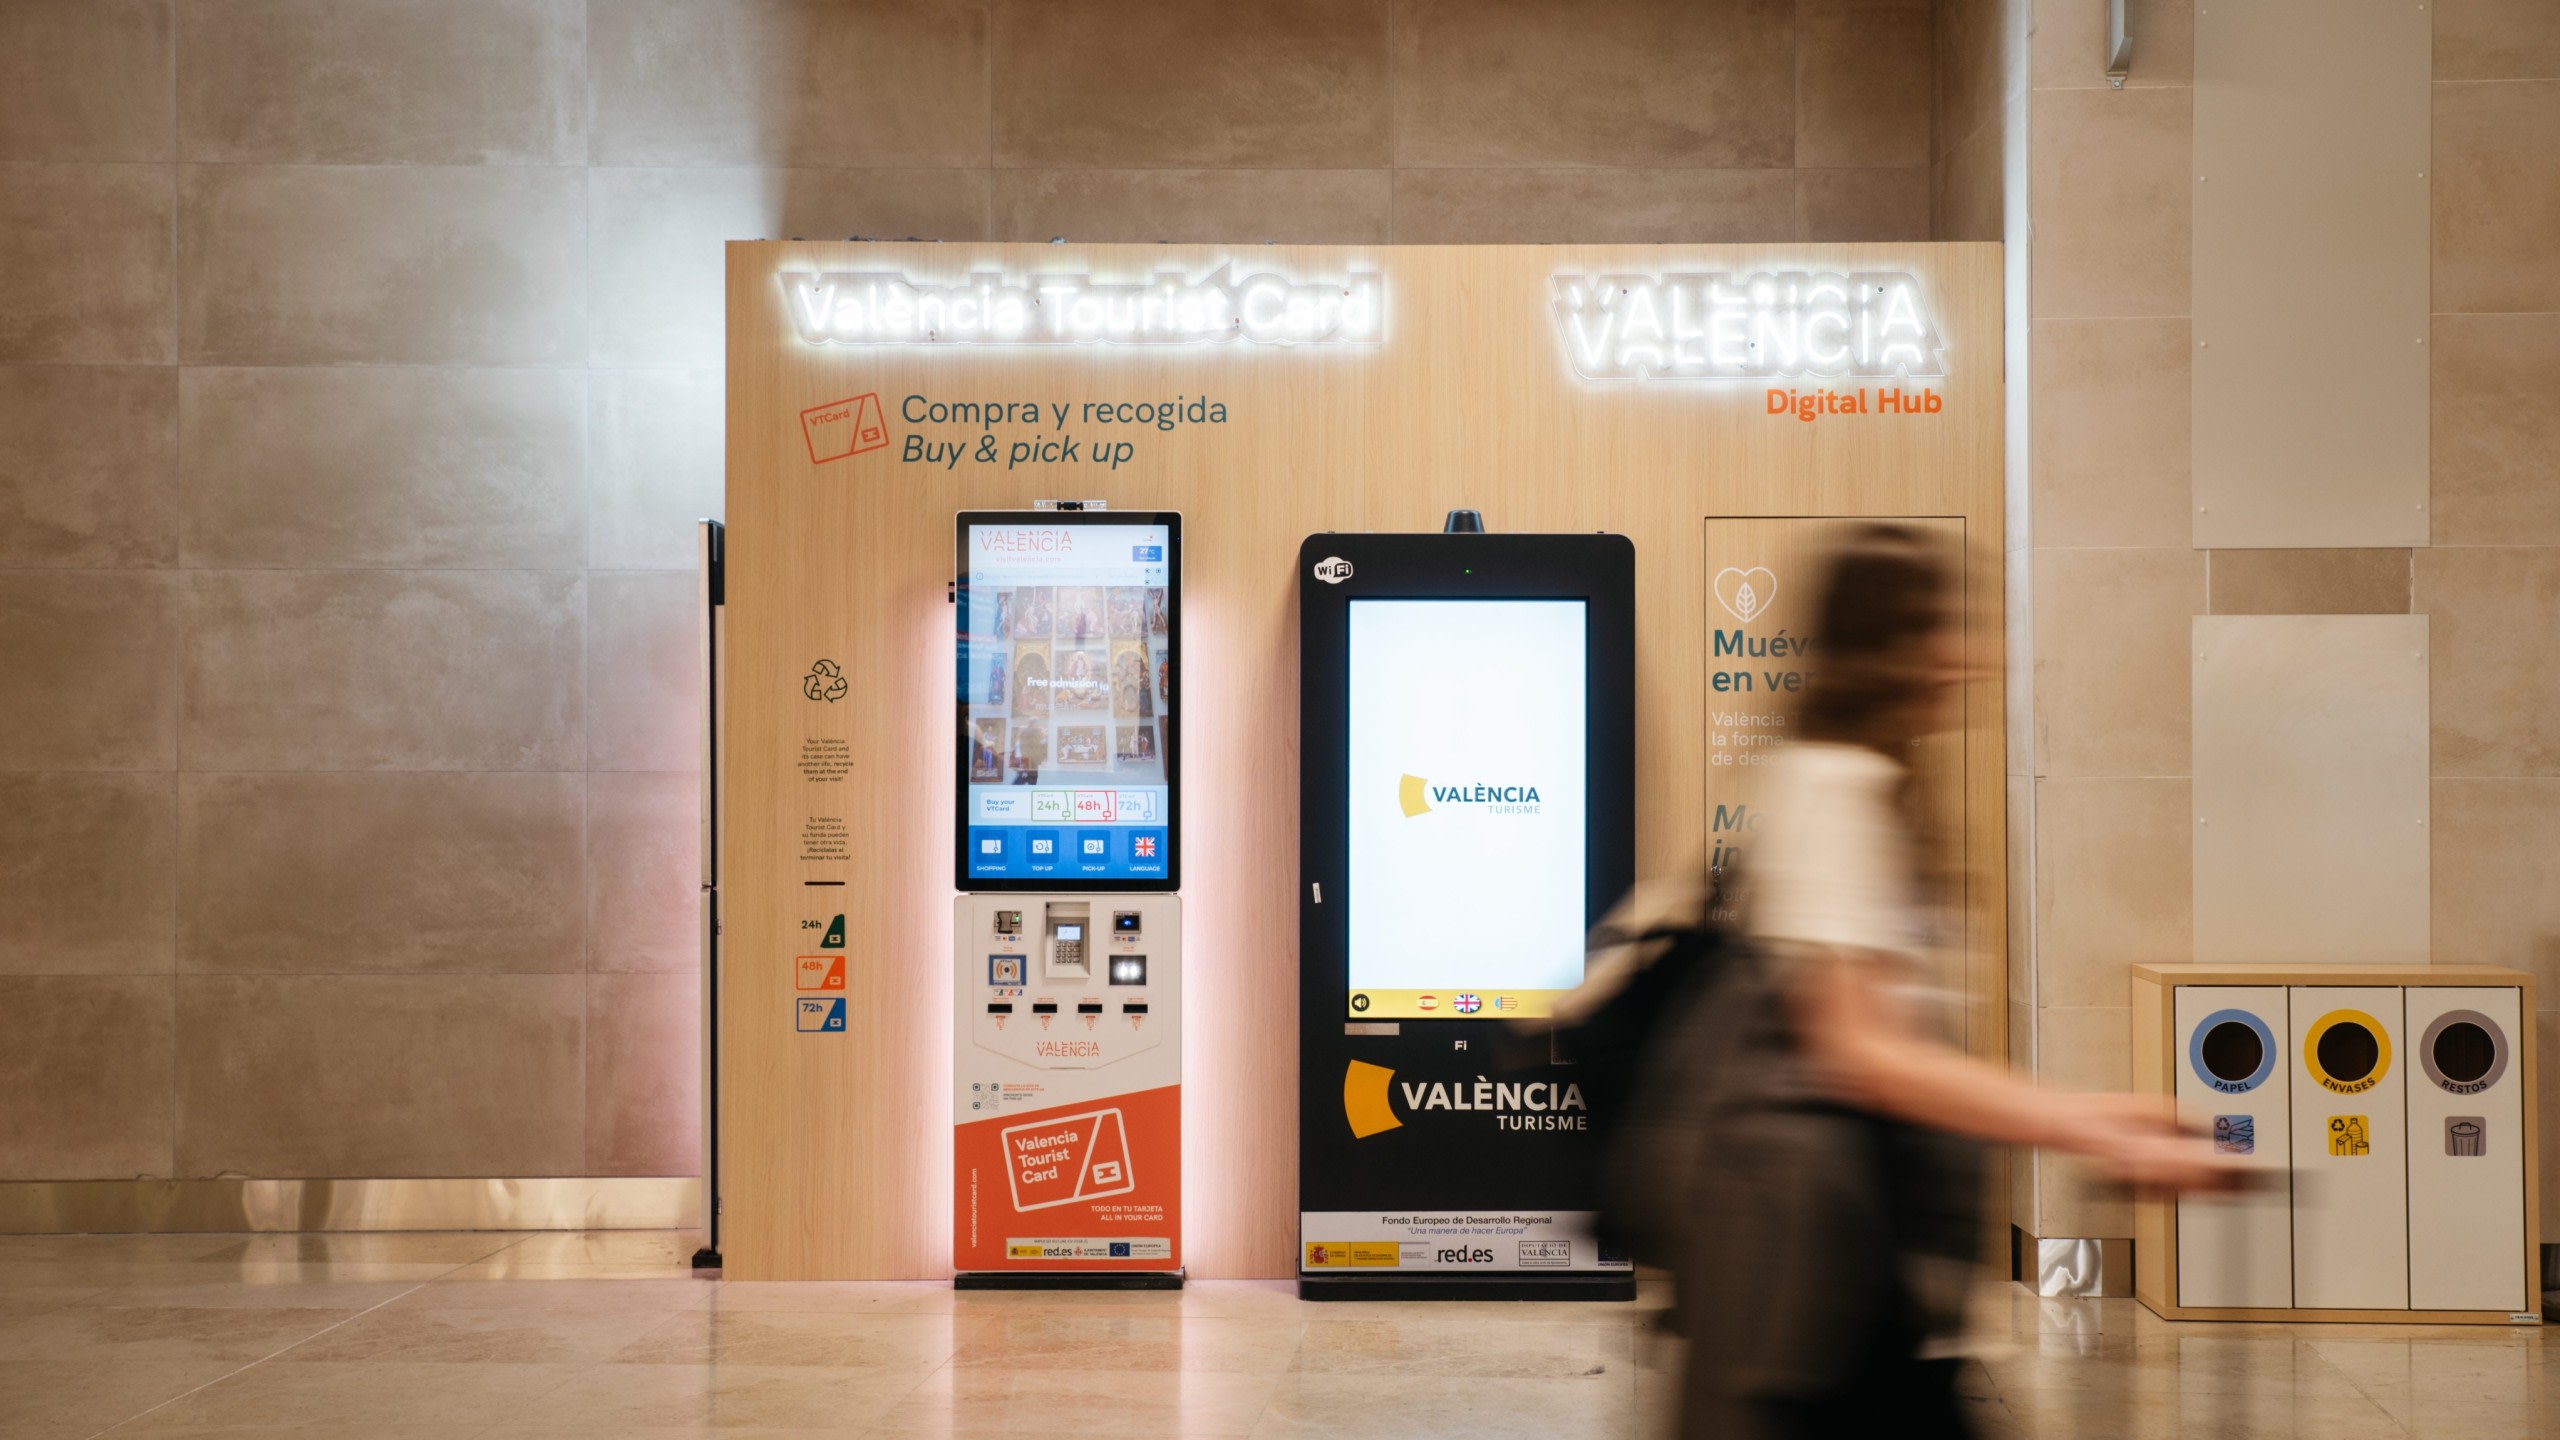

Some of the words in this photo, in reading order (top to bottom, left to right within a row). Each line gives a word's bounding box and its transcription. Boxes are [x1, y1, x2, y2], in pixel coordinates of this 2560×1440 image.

[1040, 283, 1230, 333] Tourist
[1243, 283, 1371, 332] Card
[902, 394, 1040, 431] Compra
[1052, 403, 1071, 431] y
[1083, 394, 1228, 431] recogida
[1766, 388, 1868, 422] Digital
[1878, 388, 1943, 414] Hub
[809, 408, 850, 427] VTCard
[902, 434, 967, 470] Buy
[974, 434, 998, 464] &
[1008, 434, 1081, 470] pick
[1091, 443, 1135, 470] up
[1027, 676, 1048, 687] Free
[1049, 677, 1098, 689] admission
[1711, 671, 1753, 692] en
[1711, 711, 1785, 727] València
[1711, 731, 1727, 747] la
[1731, 730, 1785, 747] forma
[1711, 751, 1734, 767] de
[1432, 782, 1540, 802] VALÈNCIA
[1037, 800, 1060, 811] 24h
[1077, 800, 1101, 811] 48h
[1118, 800, 1141, 811] 72h
[1487, 805, 1541, 814] TURISME
[801, 920, 822, 929] 24h
[802, 961, 823, 971] 48h
[802, 1003, 823, 1012] 72h
[1454, 1040, 1467, 1050] Fi
[1401, 1075, 1588, 1111] VALÈNCIA
[2213, 1079, 2252, 1092] PAPEL
[2322, 1077, 2376, 1094] ENVASES
[2440, 1079, 2488, 1094] RESTOS
[1496, 1115, 1588, 1131] TURISME
[1015, 1130, 1079, 1152] Valencia
[1018, 1148, 1070, 1168] Tourist
[1022, 1166, 1058, 1184] Card
[970, 1168, 978, 1248] valenciatouristcard.com
[1382, 1216, 1411, 1225] Fondo
[1413, 1216, 1450, 1227] Europeo
[1452, 1216, 1464, 1225] de
[1466, 1216, 1511, 1225] Desarrollo
[1513, 1216, 1552, 1227] Regional
[1459, 1227, 1470, 1235] de
[1472, 1227, 1494, 1235] hacer
[1044, 1246, 1072, 1256] red.es
[1437, 1244, 1494, 1263] red.es
